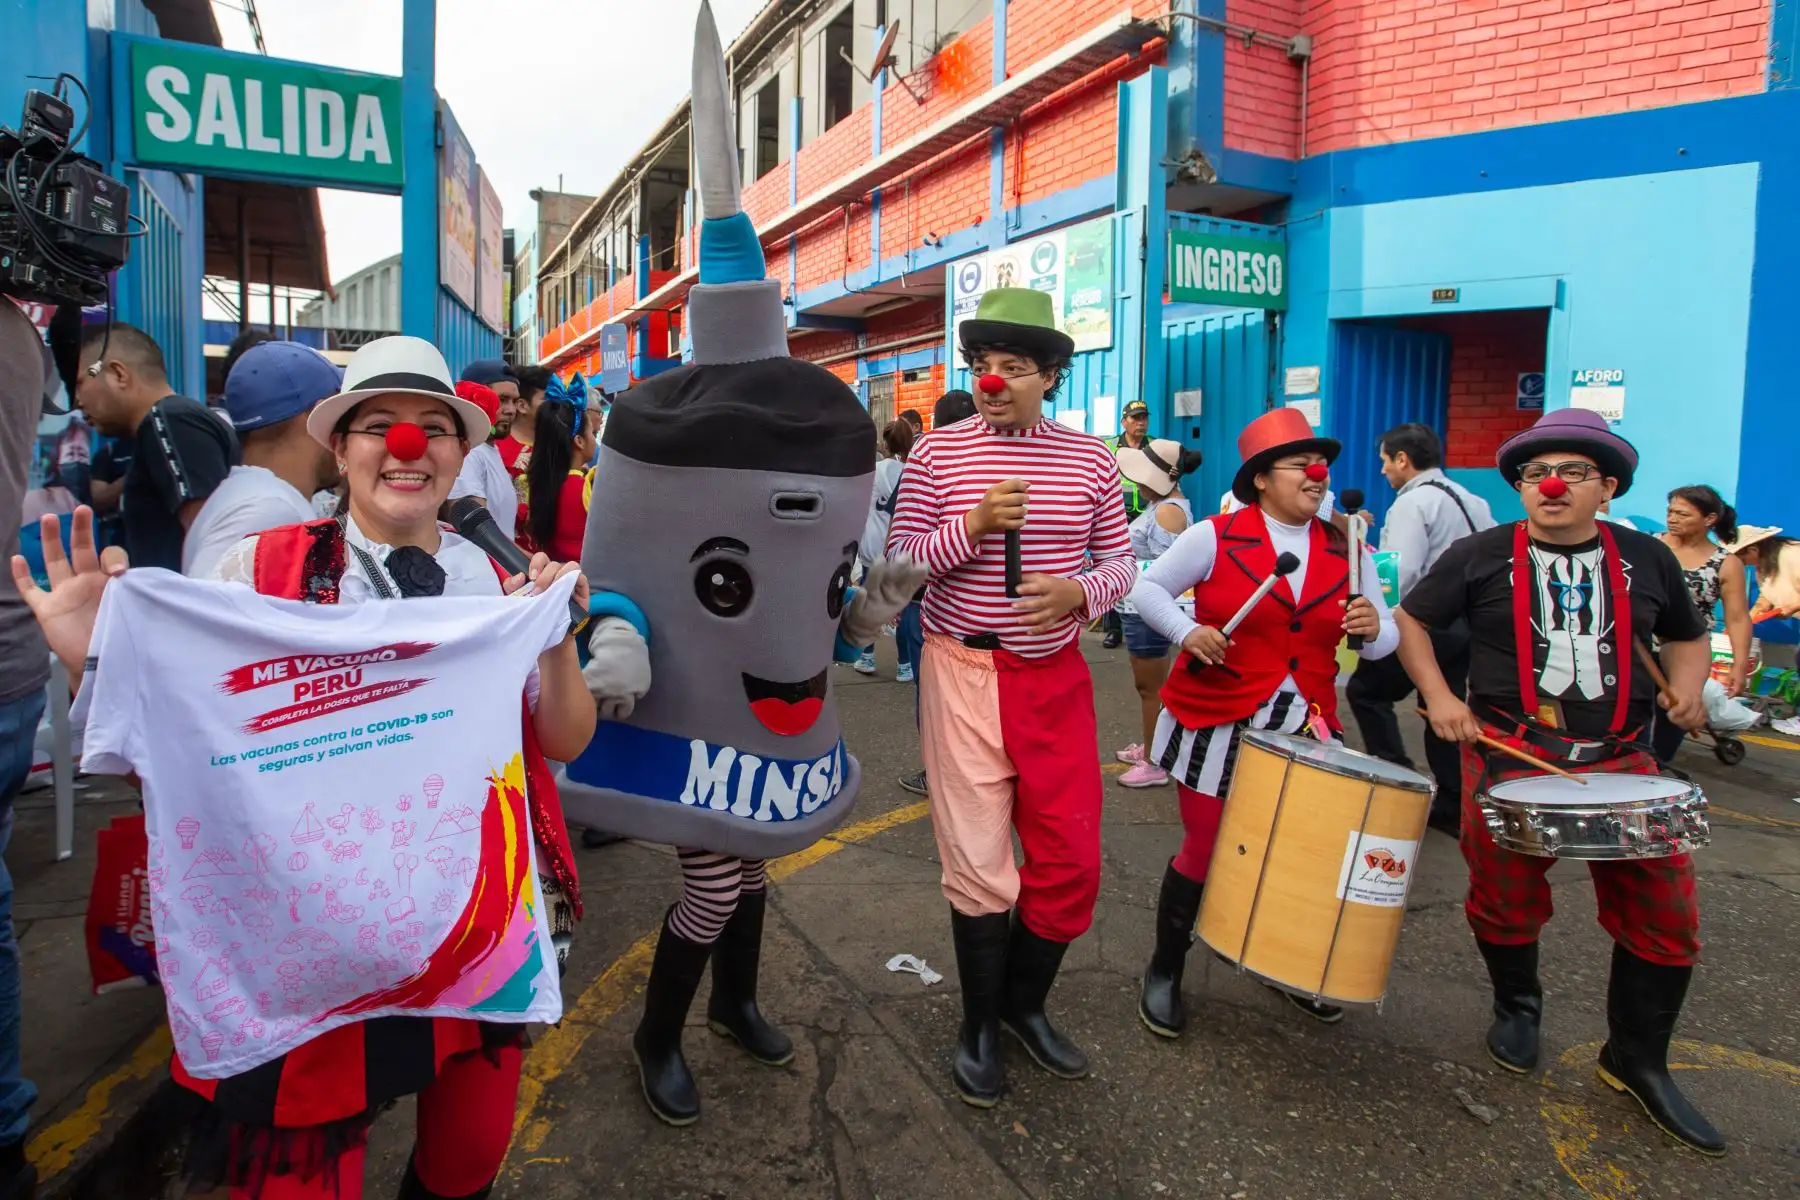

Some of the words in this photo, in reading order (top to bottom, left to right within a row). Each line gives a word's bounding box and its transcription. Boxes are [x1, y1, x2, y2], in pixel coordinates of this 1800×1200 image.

[145, 64, 392, 165] SALIDA
[1175, 243, 1283, 297] INGRESO
[603, 350, 626, 370] MINSA
[1574, 369, 1623, 383] AFORO
[252, 660, 288, 685] ME
[293, 649, 397, 674] VACUNO
[294, 664, 363, 702] PERÚ
[261, 706, 309, 728] COMPLETA
[310, 704, 323, 714] LA
[323, 697, 350, 709] DOSIS
[351, 692, 369, 704] QUE
[370, 688, 382, 697] TE
[382, 681, 410, 695] FALTA
[210, 749, 237, 767] Las
[240, 740, 300, 761] vacunas
[303, 730, 347, 747] contra
[350, 725, 363, 738] la
[366, 713, 428, 734] COVID-19
[431, 708, 454, 721] son
[258, 752, 314, 774] seguras
[316, 749, 329, 763] y
[328, 740, 373, 759] salvan
[376, 732, 414, 747] vidas.
[679, 738, 844, 822] MINSA
